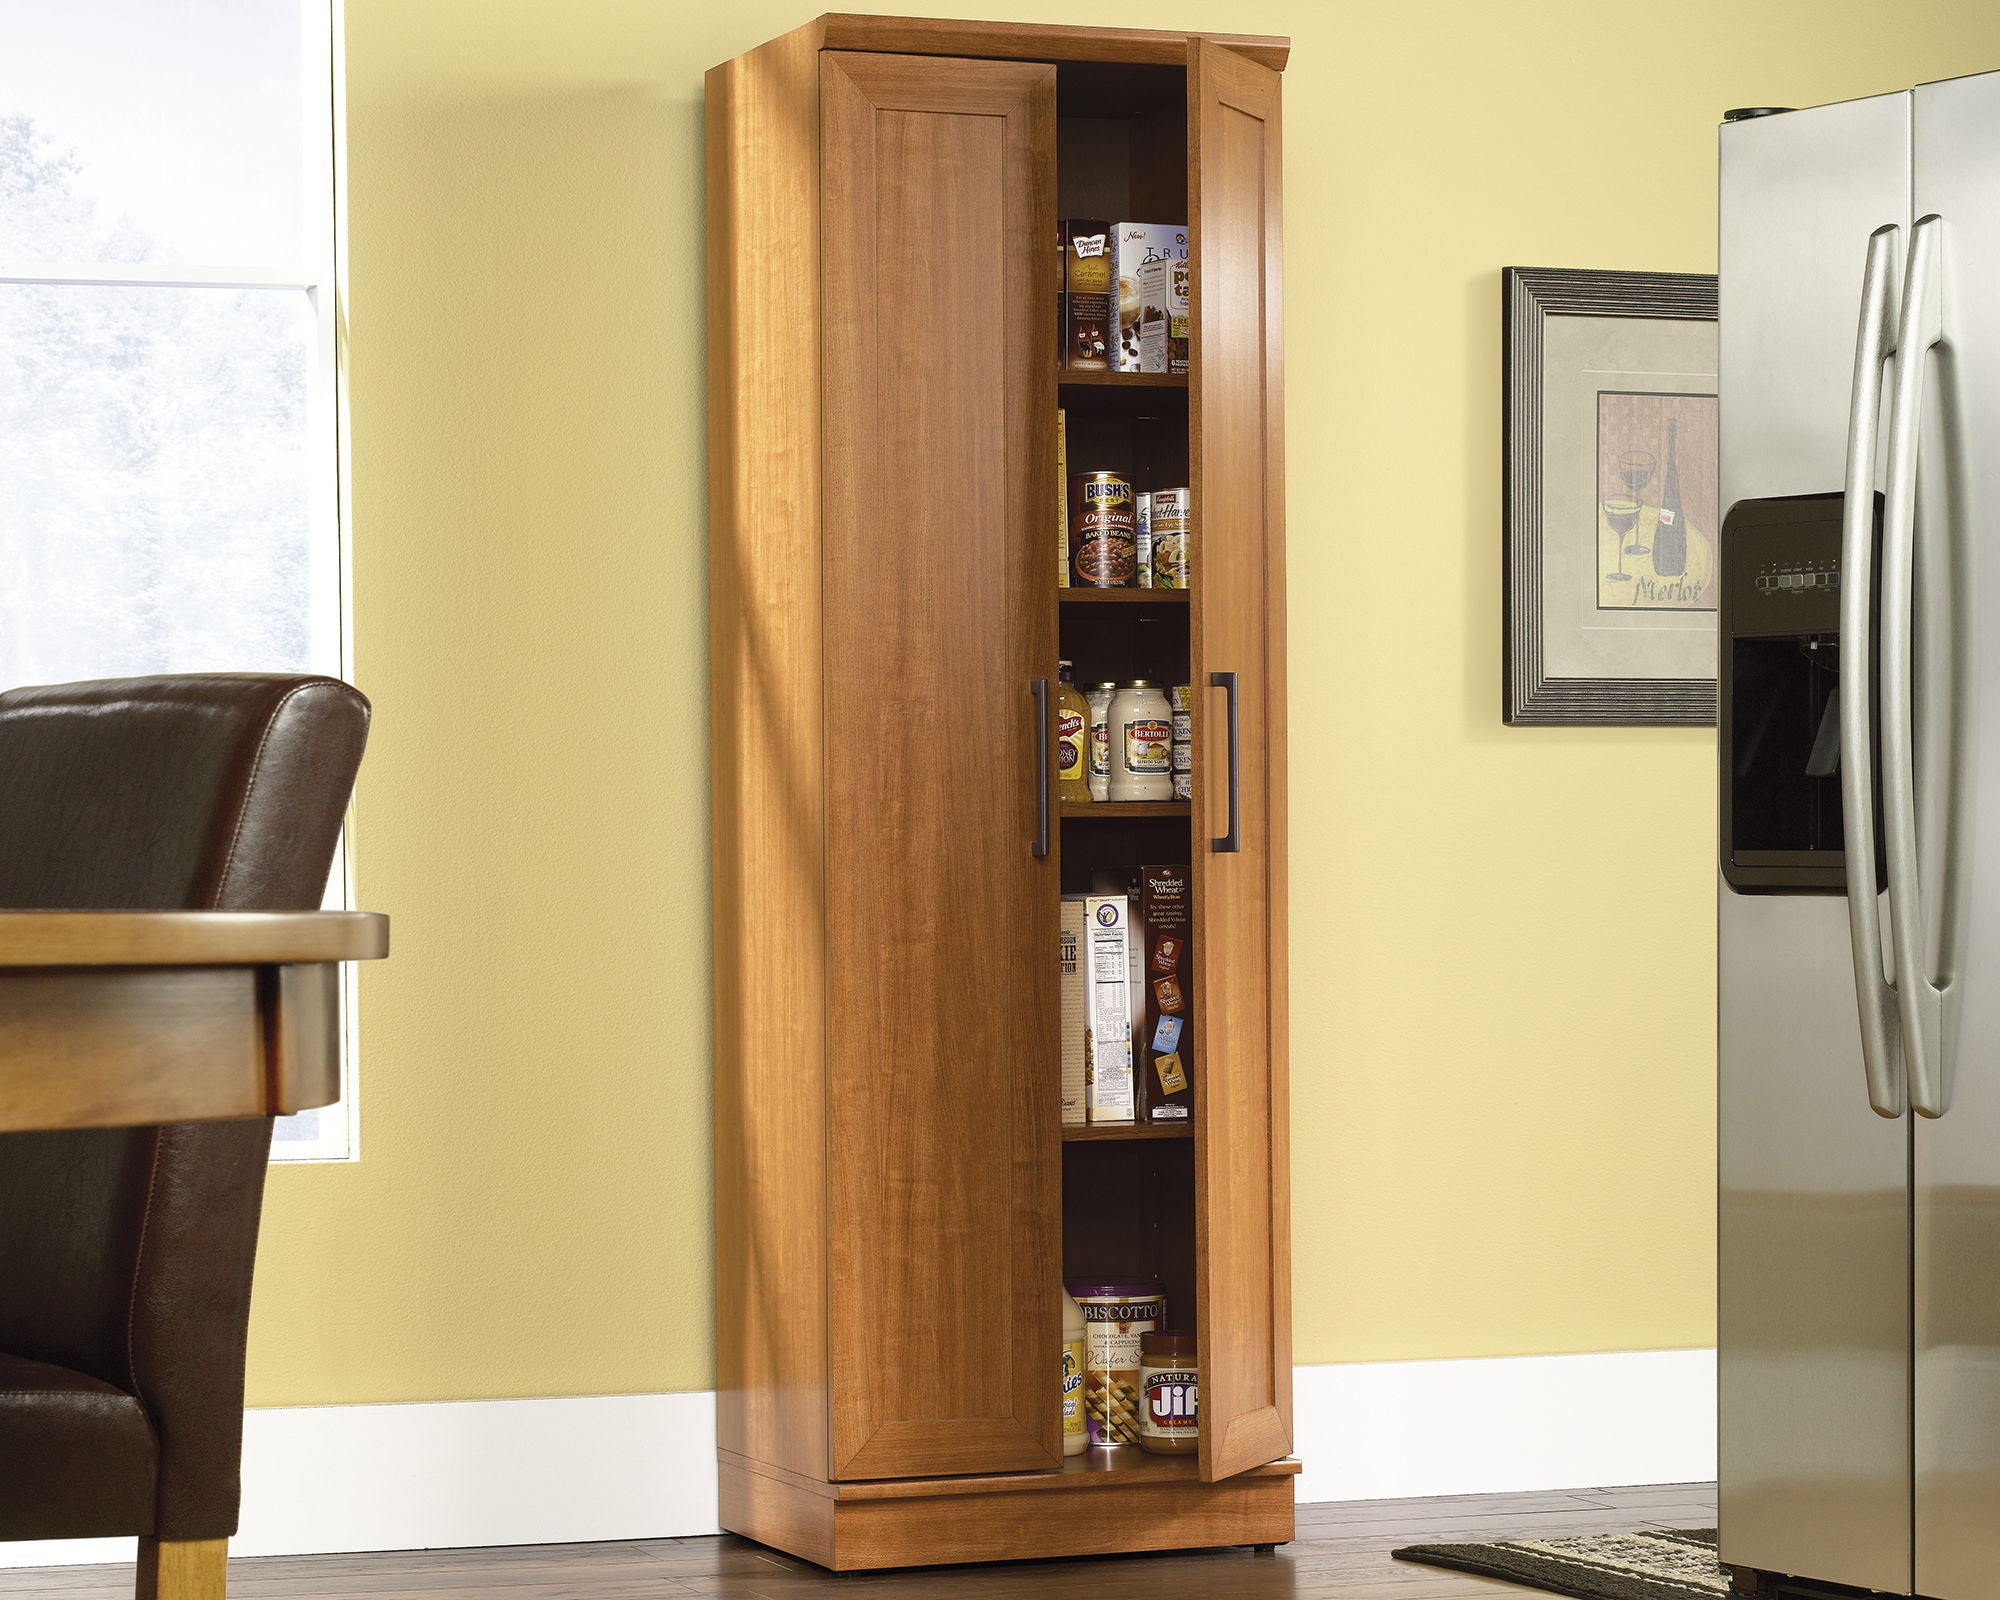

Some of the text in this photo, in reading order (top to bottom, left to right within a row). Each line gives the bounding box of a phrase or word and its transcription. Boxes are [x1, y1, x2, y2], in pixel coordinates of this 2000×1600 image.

[1124, 231, 1147, 243] New!
[1076, 239, 1102, 248] Duncan
[1081, 246, 1101, 255] Hines
[1146, 246, 1189, 260] TRU
[1087, 483, 1129, 500] BUSH'S
[1085, 511, 1132, 525] Original
[1085, 529, 1132, 540] BAKED BEANS
[1133, 730, 1169, 739] BERTOLLI
[1149, 878, 1183, 888] Shredded
[1154, 885, 1179, 894] Wheat
[1084, 1304, 1158, 1319] BISCOTTO
[1087, 1350, 1128, 1369] Wafer
[1151, 1373, 1198, 1384] NATURA
